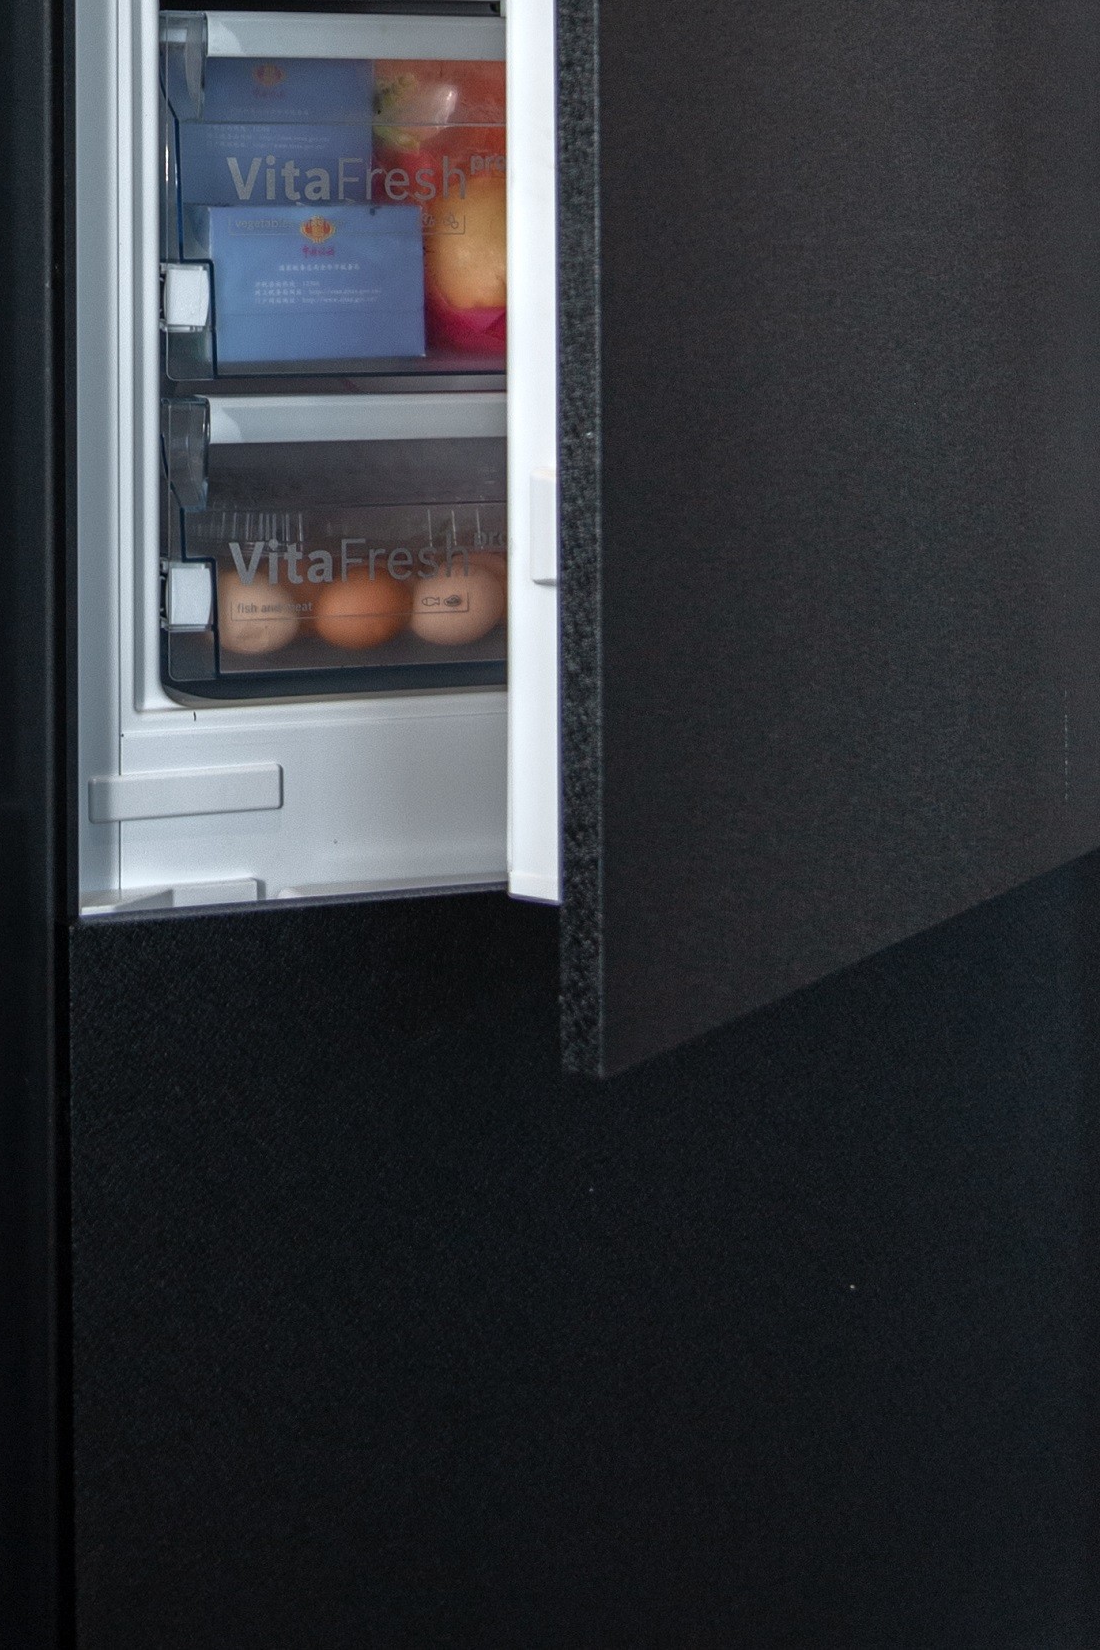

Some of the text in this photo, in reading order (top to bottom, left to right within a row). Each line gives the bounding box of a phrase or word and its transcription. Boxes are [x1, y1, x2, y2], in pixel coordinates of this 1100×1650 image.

[226, 154, 467, 201] VitaFresh
[228, 537, 470, 586] VitaFresh
[237, 602, 257, 613] fish
